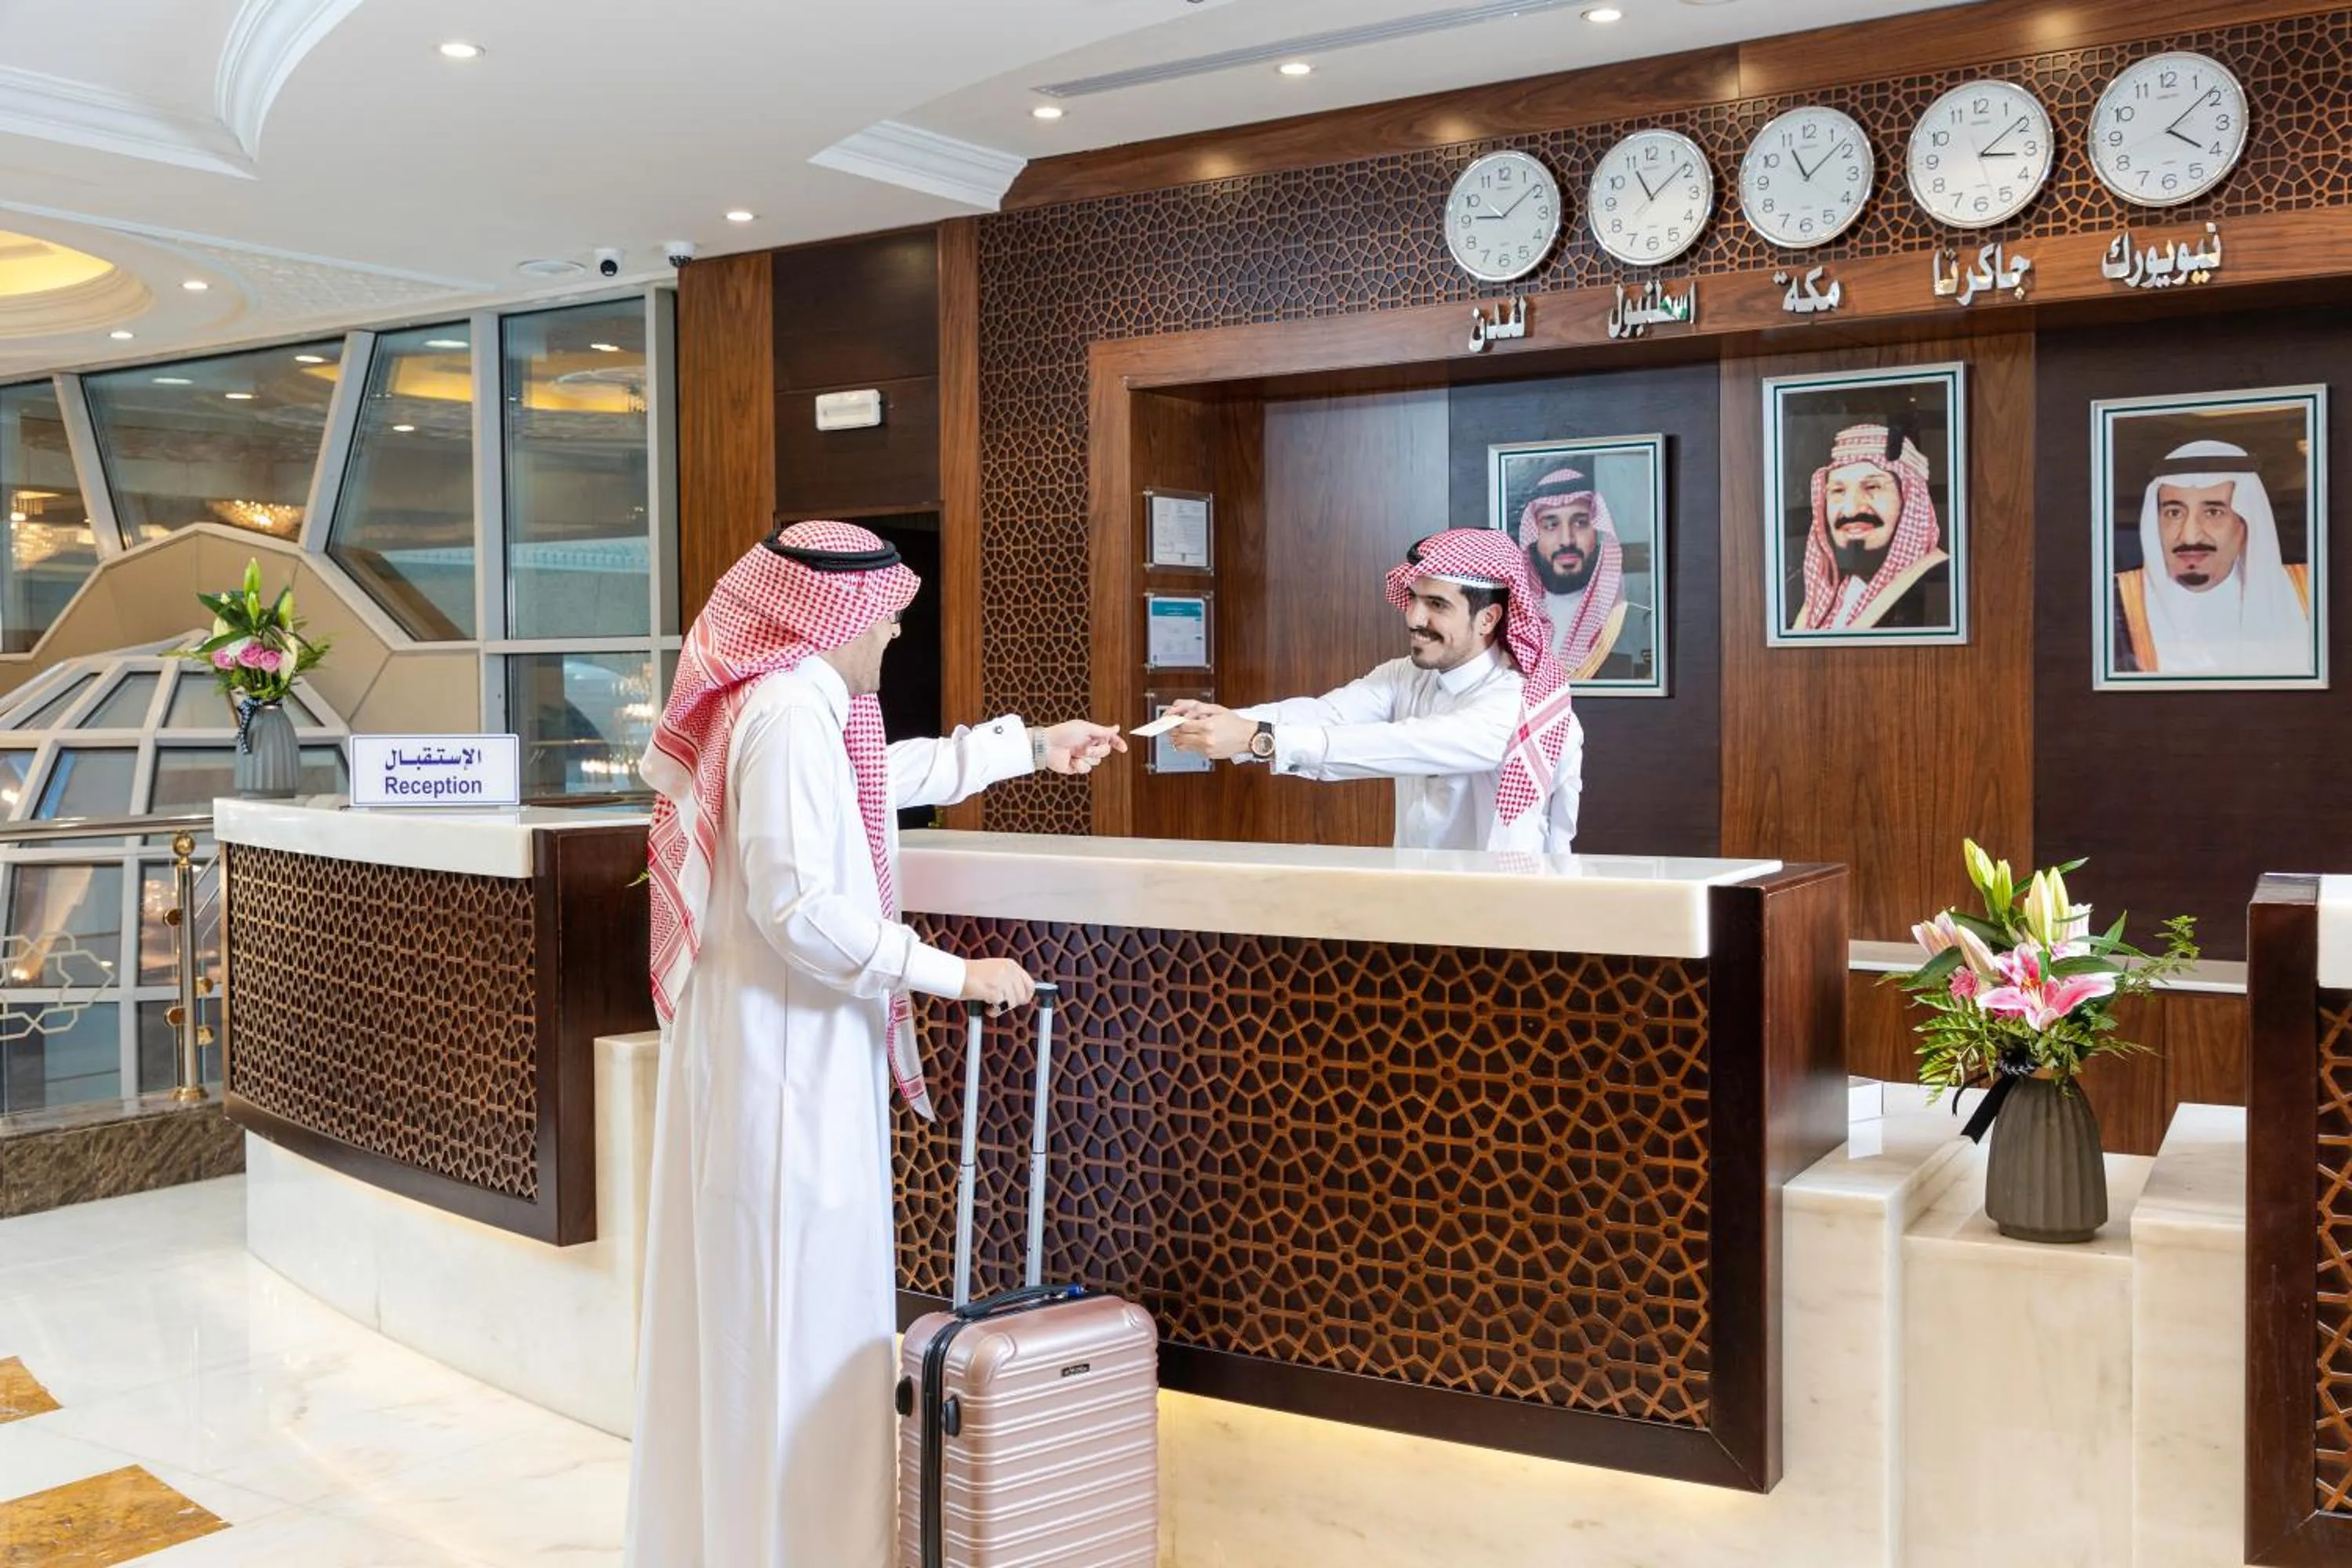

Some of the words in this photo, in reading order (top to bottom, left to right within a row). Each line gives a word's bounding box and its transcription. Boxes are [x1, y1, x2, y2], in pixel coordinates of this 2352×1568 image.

[2160, 71, 2176, 88] 12
[2136, 83, 2148, 100] 11
[2209, 90, 2221, 107] 2
[1973, 98, 1989, 114] 12
[1951, 107, 1962, 124] 11
[2115, 106, 2135, 122] 10
[2017, 118, 2030, 132] 2
[2216, 114, 2230, 131] 3
[1803, 124, 1817, 139] 12
[2109, 131, 2122, 147] 9
[1782, 132, 1792, 147] 11
[1932, 132, 1949, 147] 10
[1645, 146, 1658, 161] 12
[1842, 143, 1853, 158] 2
[2024, 140, 2037, 156] 3
[2209, 141, 2222, 157] 4
[1626, 155, 1635, 169] 11
[1764, 154, 1780, 168] 10
[1926, 155, 1938, 170] 9
[2116, 155, 2130, 171] 8
[1499, 166, 1511, 180] 12
[1683, 163, 1693, 178] 2
[1846, 166, 1859, 181] 3
[2017, 166, 2029, 182] 4
[2189, 163, 2204, 180] 5
[1482, 176, 1490, 188] 11
[1610, 176, 1625, 190] 10
[1757, 176, 1769, 191] 9
[1933, 178, 1944, 193] 8
[2136, 171, 2150, 187] 7
[2161, 174, 2177, 190] 6
[1534, 184, 1543, 198] 2
[1689, 186, 1699, 199] 3
[1841, 191, 1852, 205] 4
[1999, 187, 2013, 202] 5
[1467, 194, 1480, 208] 10
[1606, 198, 1617, 211] 9
[1762, 198, 1774, 212] 8
[1950, 192, 1962, 208] 7
[1974, 197, 1988, 212] 6
[1538, 205, 1548, 220] 3
[1684, 209, 1693, 223] 4
[1823, 209, 1835, 224] 5
[1461, 215, 1472, 227] 9
[1612, 219, 1622, 233] 8
[1778, 213, 1790, 228] 7
[1800, 218, 1813, 233] 6
[1534, 228, 1542, 239] 4
[1626, 233, 1638, 247] 7
[1668, 227, 1679, 241] 5
[1466, 236, 1475, 249] 8
[1646, 237, 1659, 251] 6
[1480, 250, 1489, 263] 7
[1519, 246, 1528, 259] 5
[2101, 221, 2221, 289] نيويورك
[1499, 254, 1510, 267] 6
[1933, 242, 2031, 307] جاكرتا
[1773, 265, 1840, 313] مكة
[1608, 279, 1695, 339] اسطنبول
[1468, 295, 1526, 353] لندن
[386, 776, 482, 798] Reception
